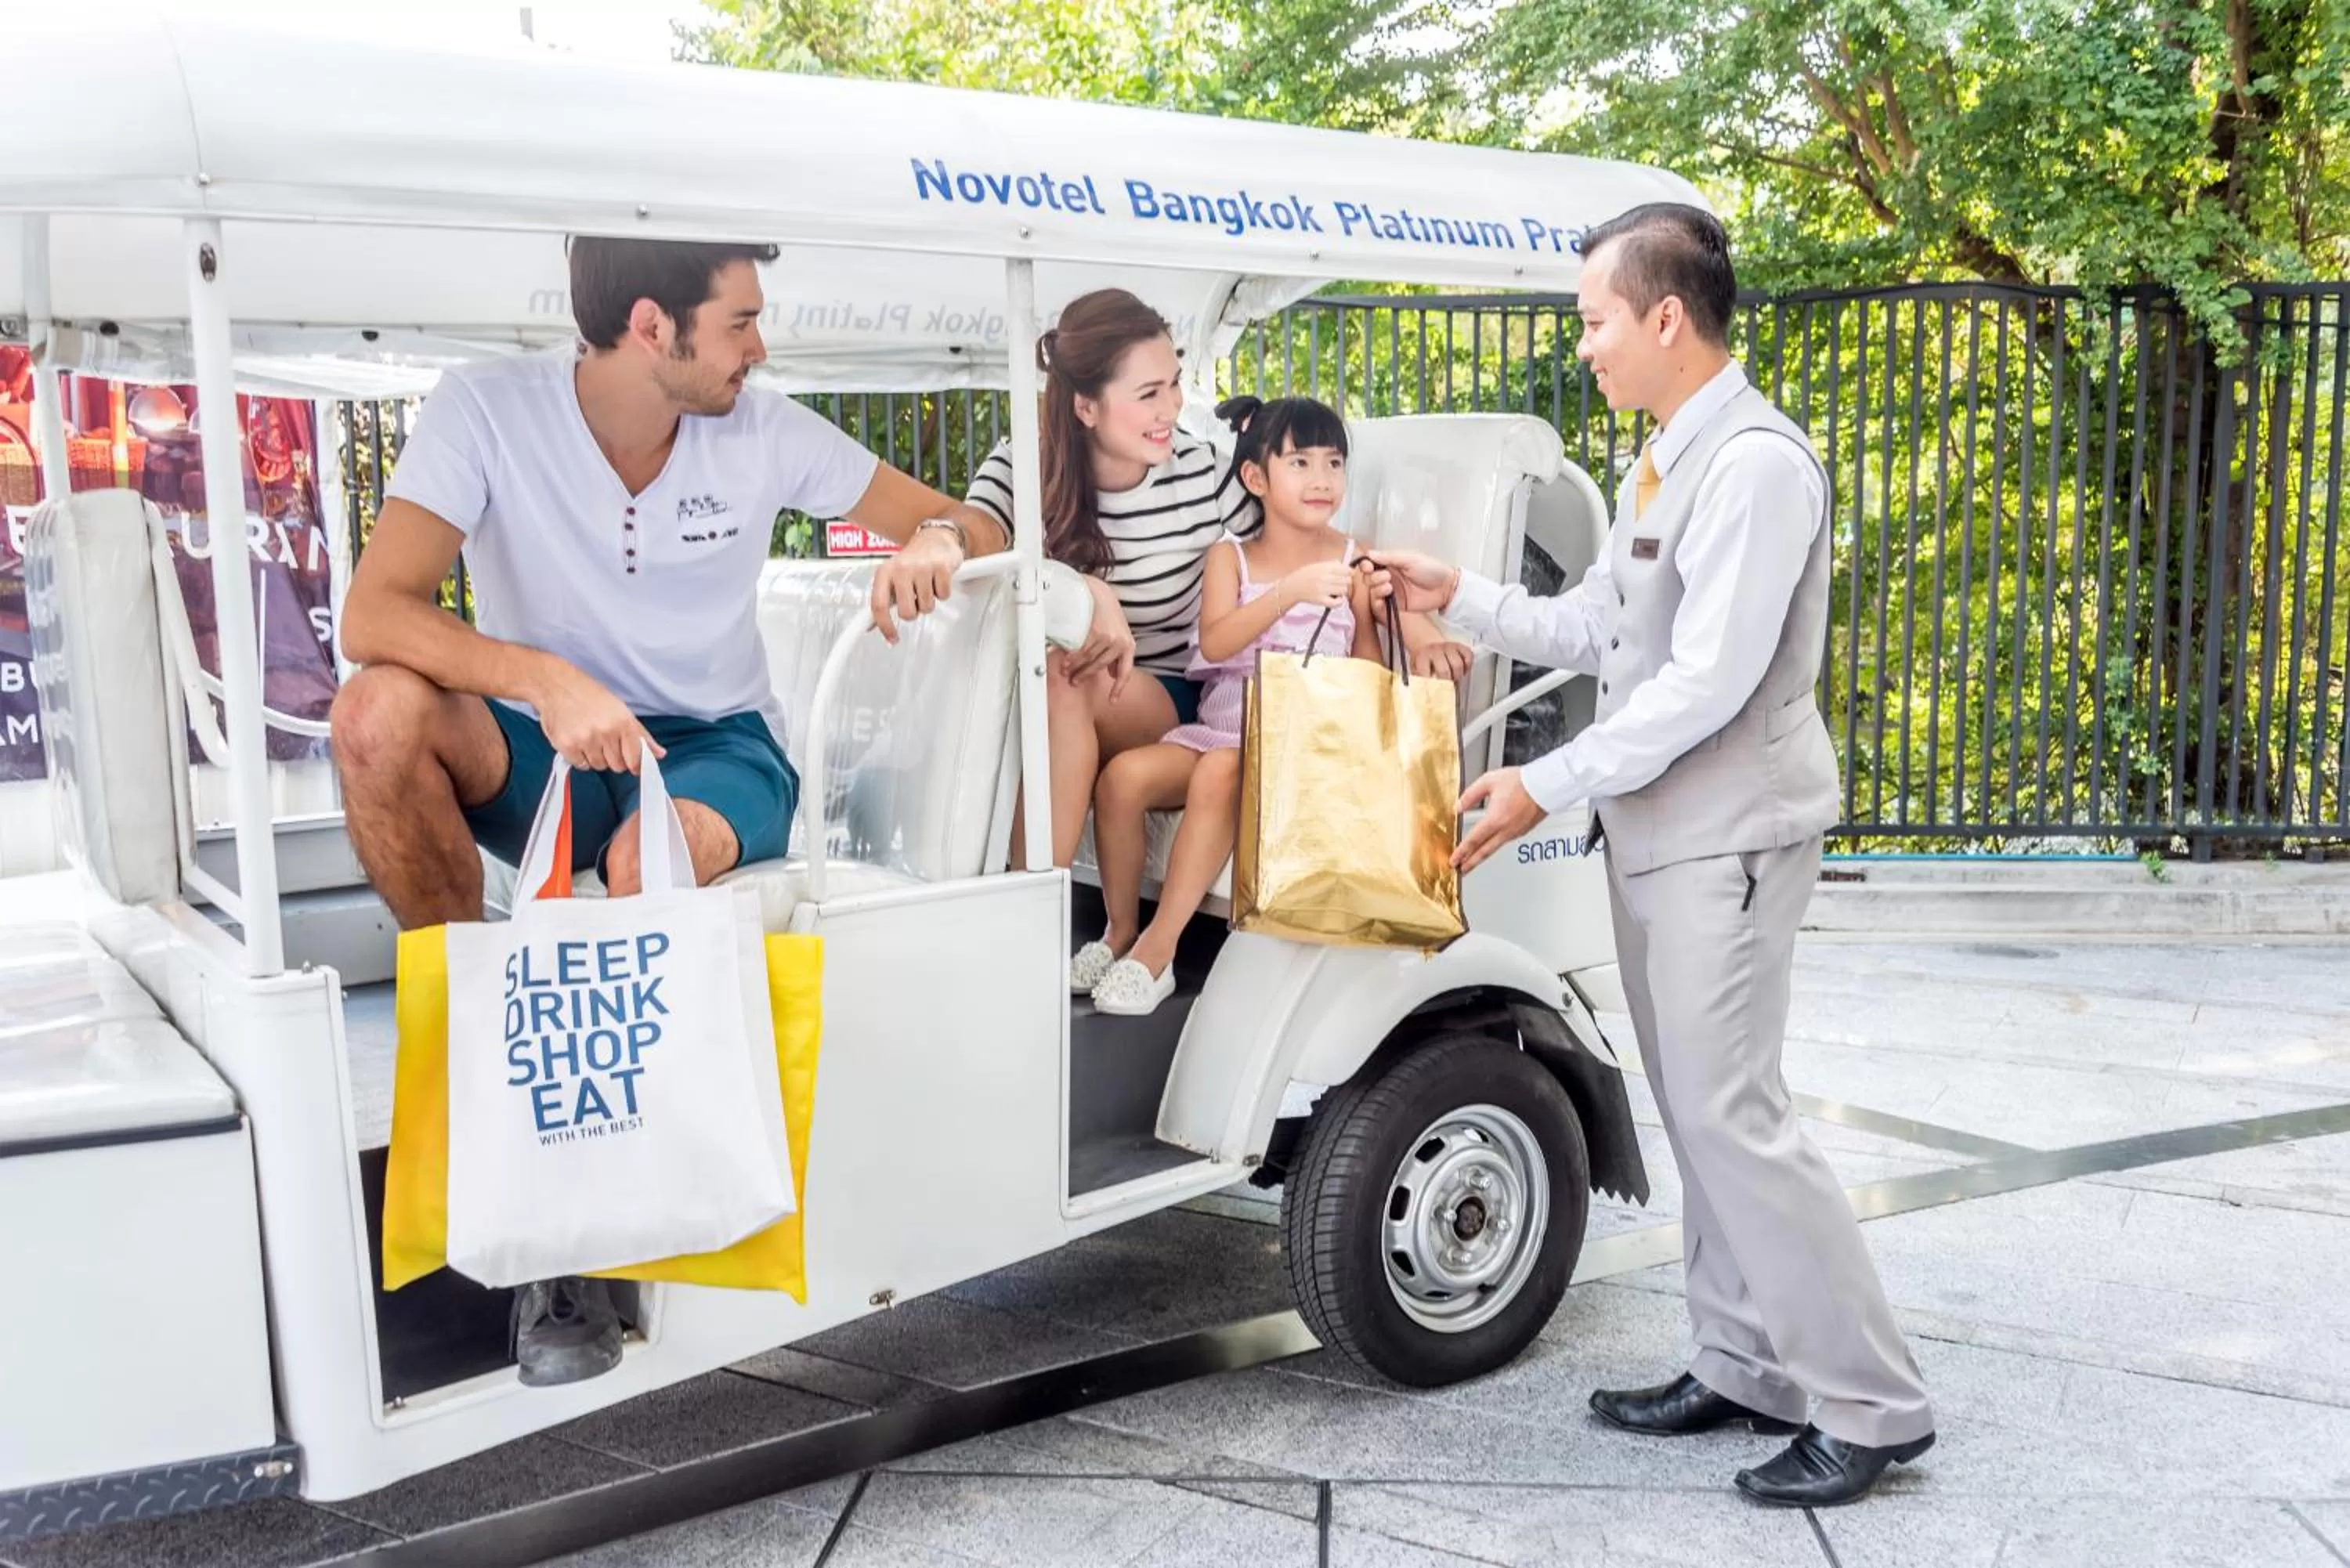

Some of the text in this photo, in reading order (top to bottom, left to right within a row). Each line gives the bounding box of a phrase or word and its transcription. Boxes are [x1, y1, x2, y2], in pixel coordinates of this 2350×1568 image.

[910, 157, 1106, 215] Novotel
[1124, 178, 1325, 236] Bangkok
[1521, 218, 1589, 254] Pra
[830, 529, 897, 549] HIGH ZO
[504, 932, 671, 999] SLEEP
[504, 976, 671, 1043] DRINK
[508, 1021, 662, 1086] SHOP
[530, 1067, 645, 1132] EAT
[539, 1117, 644, 1147] WITH THE BEST
